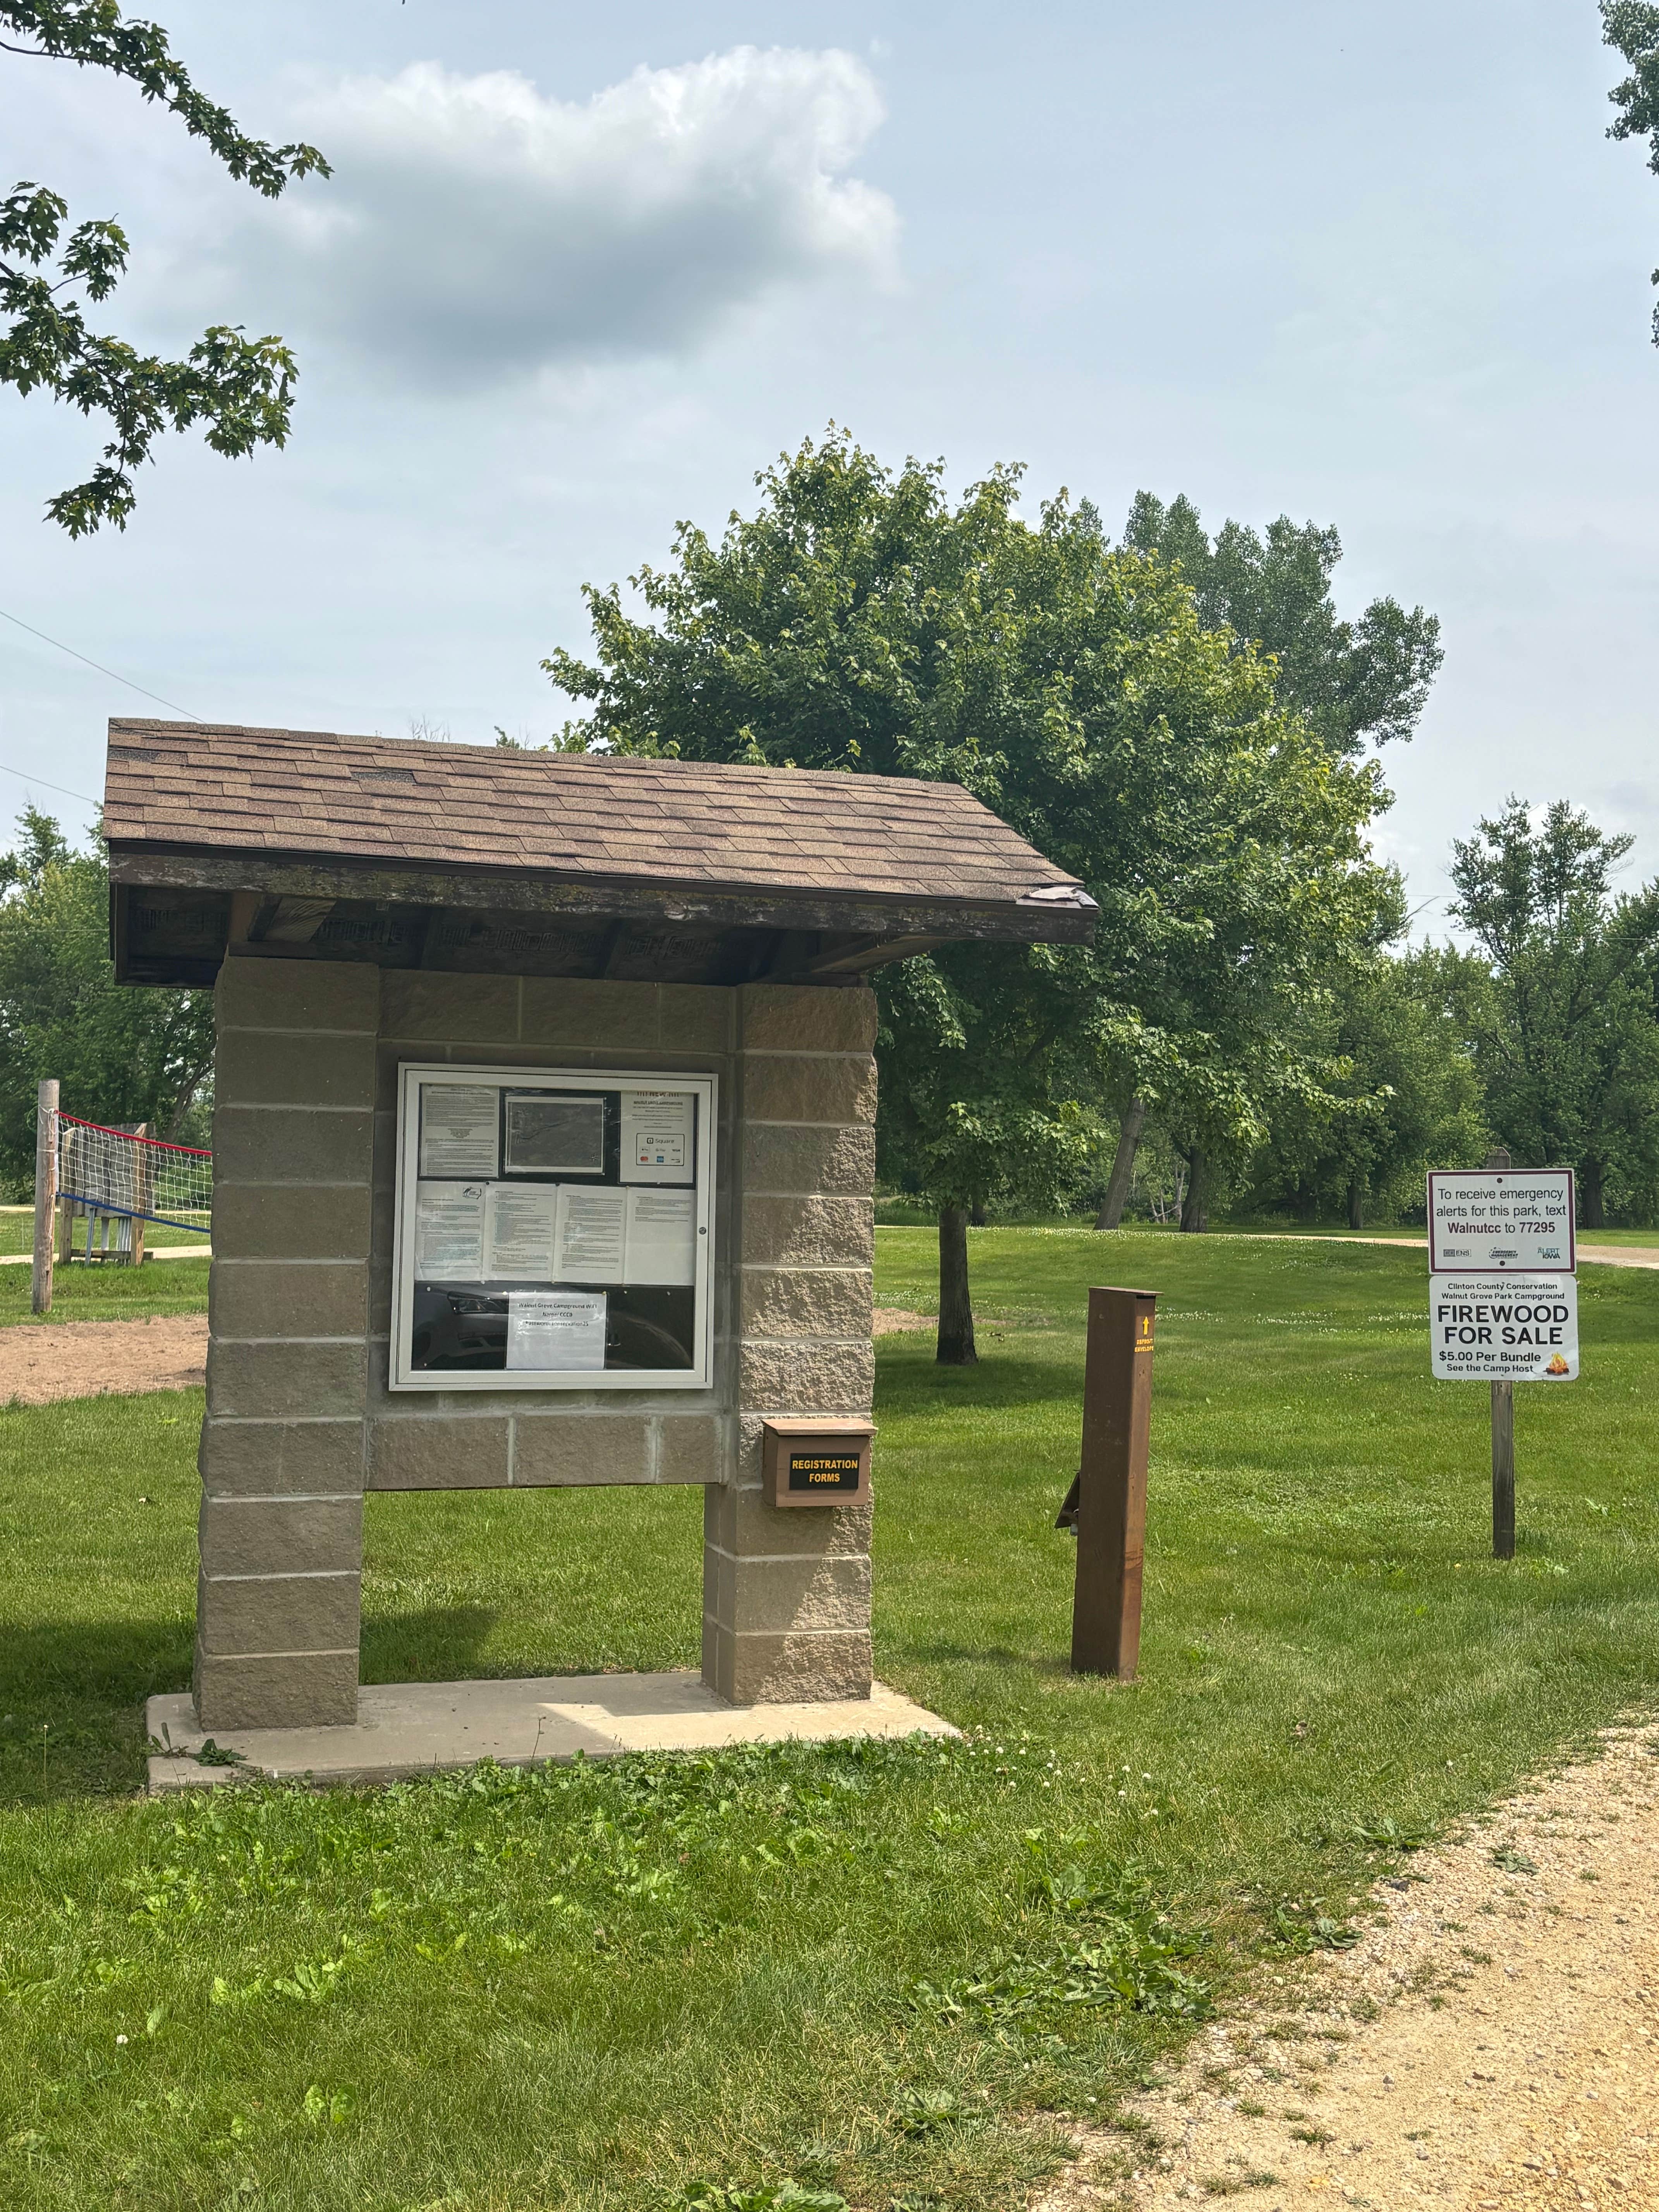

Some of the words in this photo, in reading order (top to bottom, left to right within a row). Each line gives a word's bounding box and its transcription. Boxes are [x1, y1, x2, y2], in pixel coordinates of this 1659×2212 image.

[1438, 1188, 1452, 1200] To
[1455, 1188, 1496, 1200] receive
[1499, 1190, 1564, 1201] emergency
[1436, 1206, 1467, 1217] alerts
[1471, 1205, 1487, 1216] for
[1490, 1205, 1510, 1216] this
[1513, 1205, 1541, 1218] park,
[1546, 1205, 1567, 1216] text
[1448, 1222, 1501, 1233] Walnutcc
[1505, 1223, 1515, 1233] to
[1519, 1222, 1556, 1233] 77295
[1515, 1293, 1565, 1301] Campground
[1437, 1305, 1569, 1323] FIREWOOD
[1444, 1327, 1492, 1344] FOR
[1501, 1327, 1563, 1345] SALE
[1439, 1350, 1473, 1361] $5.00
[1476, 1352, 1497, 1362] Per
[1501, 1352, 1541, 1362] Bundle
[1483, 1364, 1510, 1373] Camp
[1512, 1364, 1534, 1372] Host
[792, 1459, 858, 1469] REGISTRATION
[809, 1473, 840, 1482] FORMS
